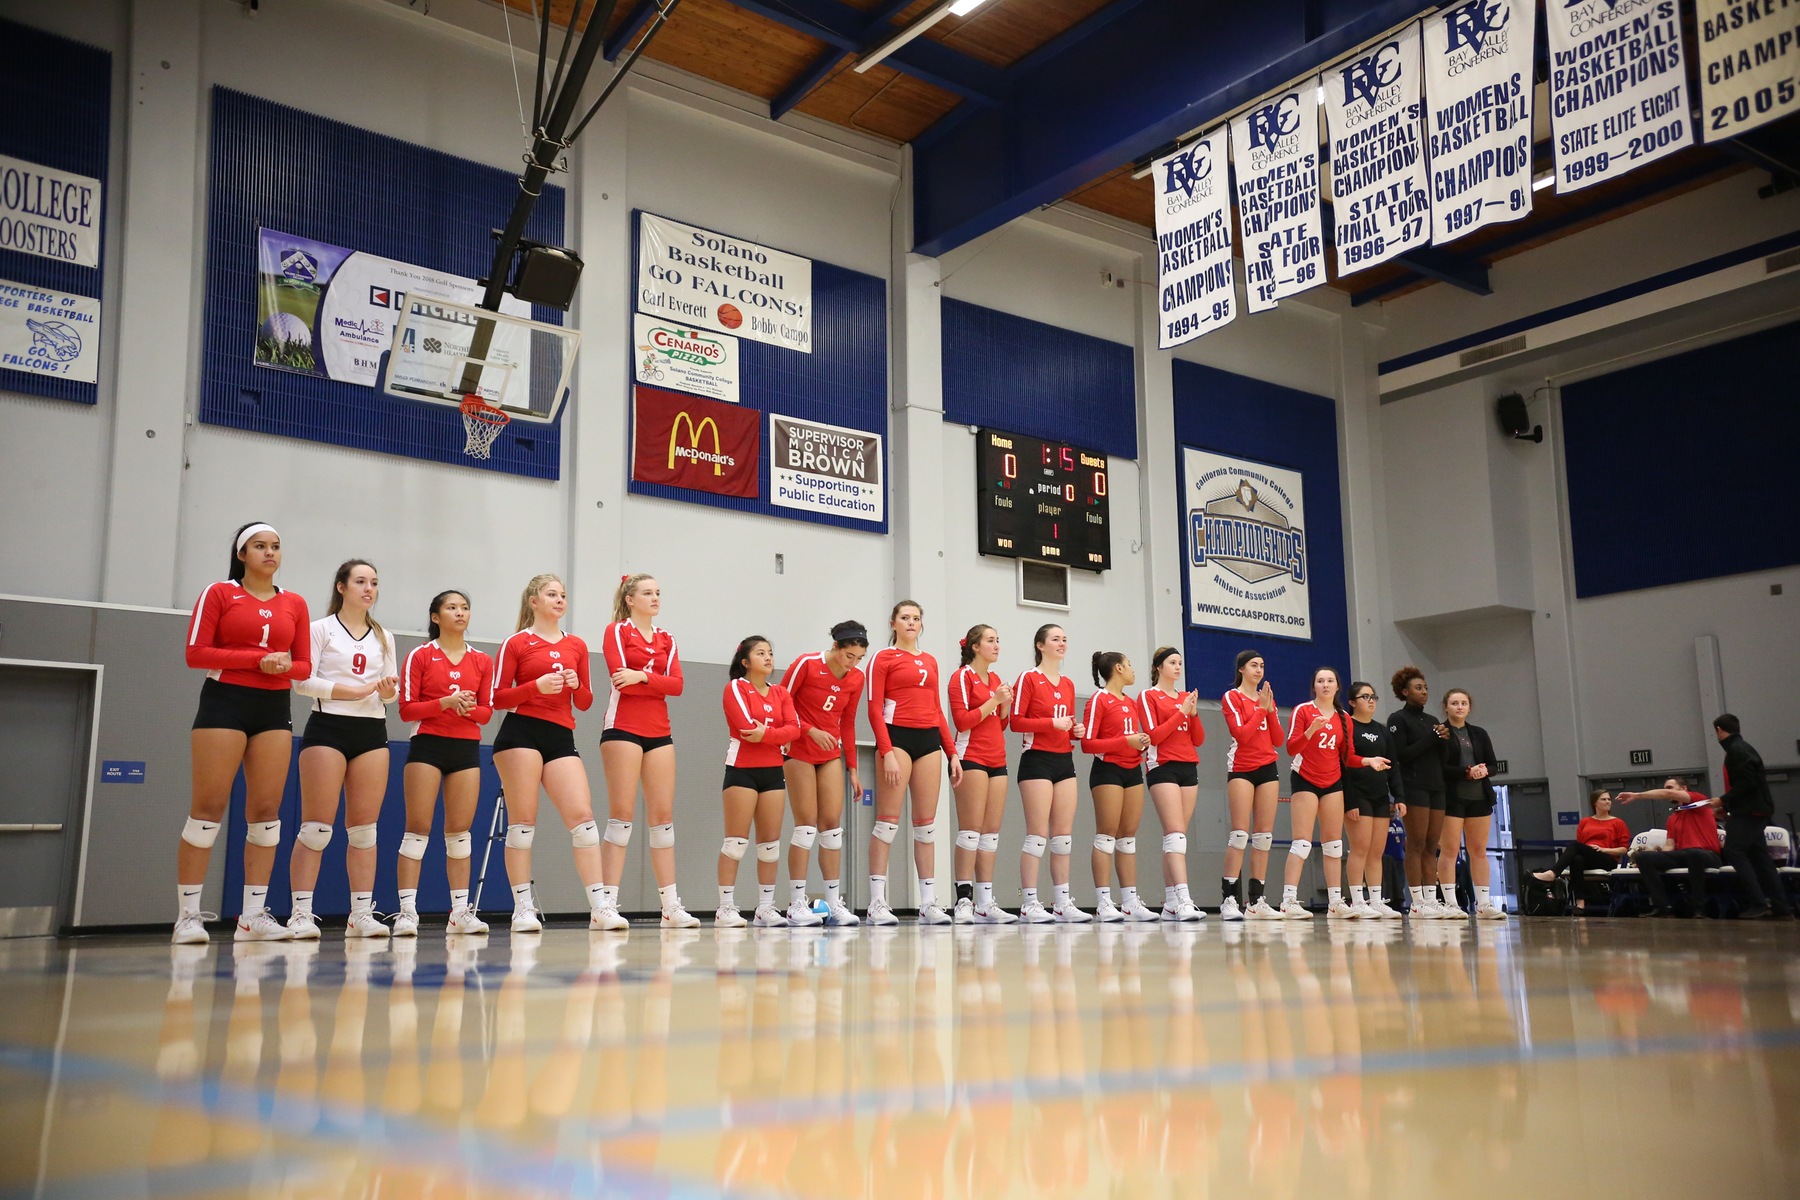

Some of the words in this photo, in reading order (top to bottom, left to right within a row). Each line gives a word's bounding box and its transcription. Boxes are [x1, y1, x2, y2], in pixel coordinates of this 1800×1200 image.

[1569, 0, 1596, 23] BAY
[1555, 1, 1674, 67] WOMEN'S
[1449, 48, 1469, 66] BAY
[1554, 20, 1678, 92] BASKETBALL
[1554, 42, 1679, 118] CHAMPIONS
[1345, 93, 1402, 129] CONFERENCE
[1346, 101, 1364, 118] BAY
[1436, 72, 1521, 131] WOMENS
[1560, 123, 1598, 155] STATE
[1603, 106, 1637, 140] ELITE
[1641, 85, 1680, 122] EIGHT
[0, 166, 92, 228] OLLEGE
[1166, 185, 1214, 215] CONFERENCE
[1167, 191, 1183, 206] BAY
[1349, 176, 1413, 221] STATE
[1337, 213, 1381, 247] FINAL
[1388, 188, 1429, 227] FOUR
[1159, 208, 1222, 253] WOMEN'S
[691, 231, 767, 264] Solano
[1282, 236, 1321, 267] FOUR
[668, 245, 784, 290] Basketball
[390, 267, 409, 278] Thank
[410, 271, 422, 280] You
[435, 276, 448, 286] Golf
[448, 280, 474, 292] Sponsors
[648, 264, 682, 285] GO
[692, 276, 804, 317] FALCONS!
[27, 303, 94, 323] BASKETBALL
[61, 298, 76, 307] OF
[642, 288, 665, 307] Carl
[668, 296, 707, 318] Everett
[335, 317, 357, 328] Medic
[751, 316, 778, 336] Bobby
[780, 323, 808, 346] Campo
[340, 330, 380, 344] Ambulance
[3, 353, 58, 372] FALCONS
[28, 346, 47, 357] GO
[671, 350, 704, 364] PIZZA
[670, 366, 687, 374] Solano
[687, 370, 714, 380] Community
[715, 376, 733, 385] College
[685, 376, 718, 387] BASKETBALL
[789, 426, 865, 451] SUPERVISOR
[991, 433, 1013, 449] Home
[674, 446, 735, 467] McDonald's
[789, 438, 865, 462] MONICA
[1080, 453, 1105, 469] Guests
[788, 449, 865, 479] BROWN
[1004, 453, 1016, 478] 0
[795, 474, 860, 496] Supporting
[1037, 483, 1061, 496] period
[1065, 484, 1075, 501] 0
[1094, 472, 1106, 496] 0
[1195, 466, 1227, 491] California
[1228, 466, 1268, 485] Community
[1269, 481, 1294, 510] College
[779, 486, 815, 503] Public
[818, 493, 876, 512] Education
[994, 495, 1013, 508] fouls
[1038, 502, 1062, 516] player
[1085, 511, 1102, 525] fouls
[1054, 523, 1058, 539] 1
[997, 537, 1013, 548] won
[1042, 545, 1060, 556] game
[1190, 510, 1304, 583] CHAMPIONSHIPS
[1088, 552, 1102, 563] won
[1213, 573, 1243, 598] Athletic
[1245, 585, 1286, 601] Association
[1197, 602, 1305, 626] WWW.CCCAASPORTS.ORG
[258, 623, 270, 648] 1
[351, 653, 367, 675] 9
[919, 669, 928, 687] 7
[822, 695, 837, 711] 6
[1123, 717, 1135, 735] 11
[1318, 732, 1336, 750] 24
[1632, 751, 1649, 764] EXIT
